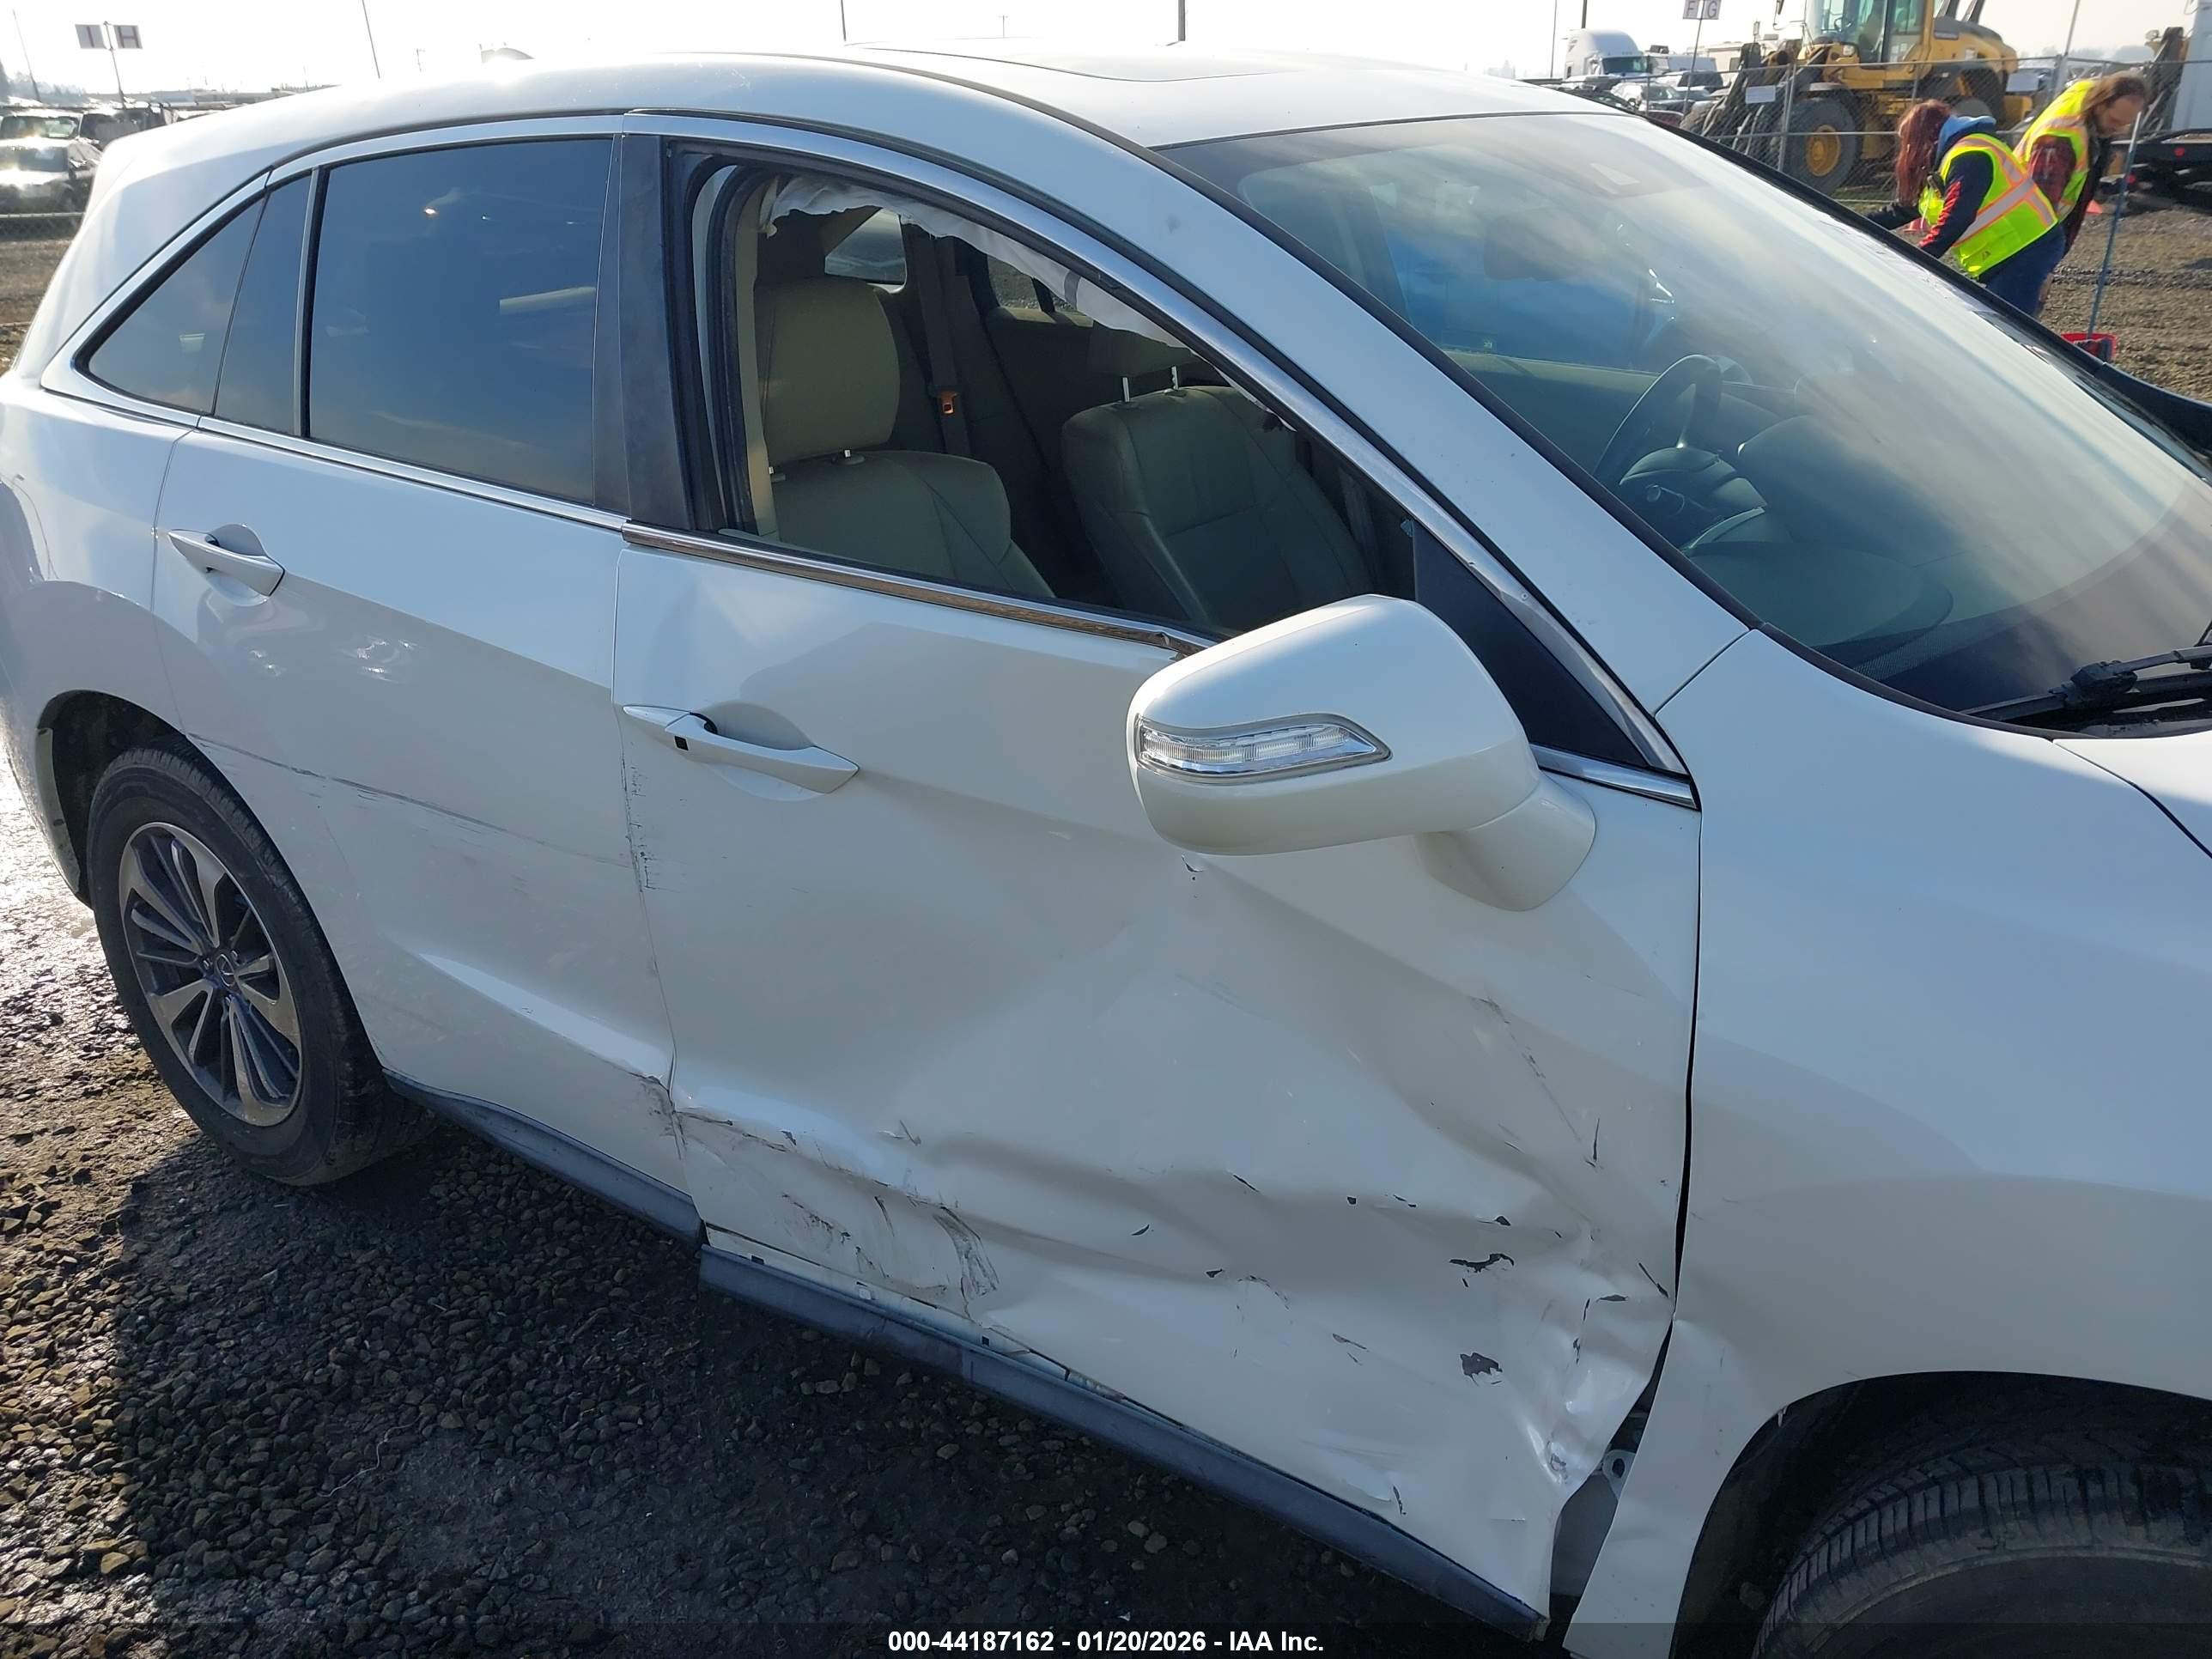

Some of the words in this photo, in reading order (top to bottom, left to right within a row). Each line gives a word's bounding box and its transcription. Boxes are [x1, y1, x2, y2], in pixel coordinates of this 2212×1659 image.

[1686, 0, 1697, 17] F
[1707, 0, 1718, 18] G
[118, 26, 141, 49] H
